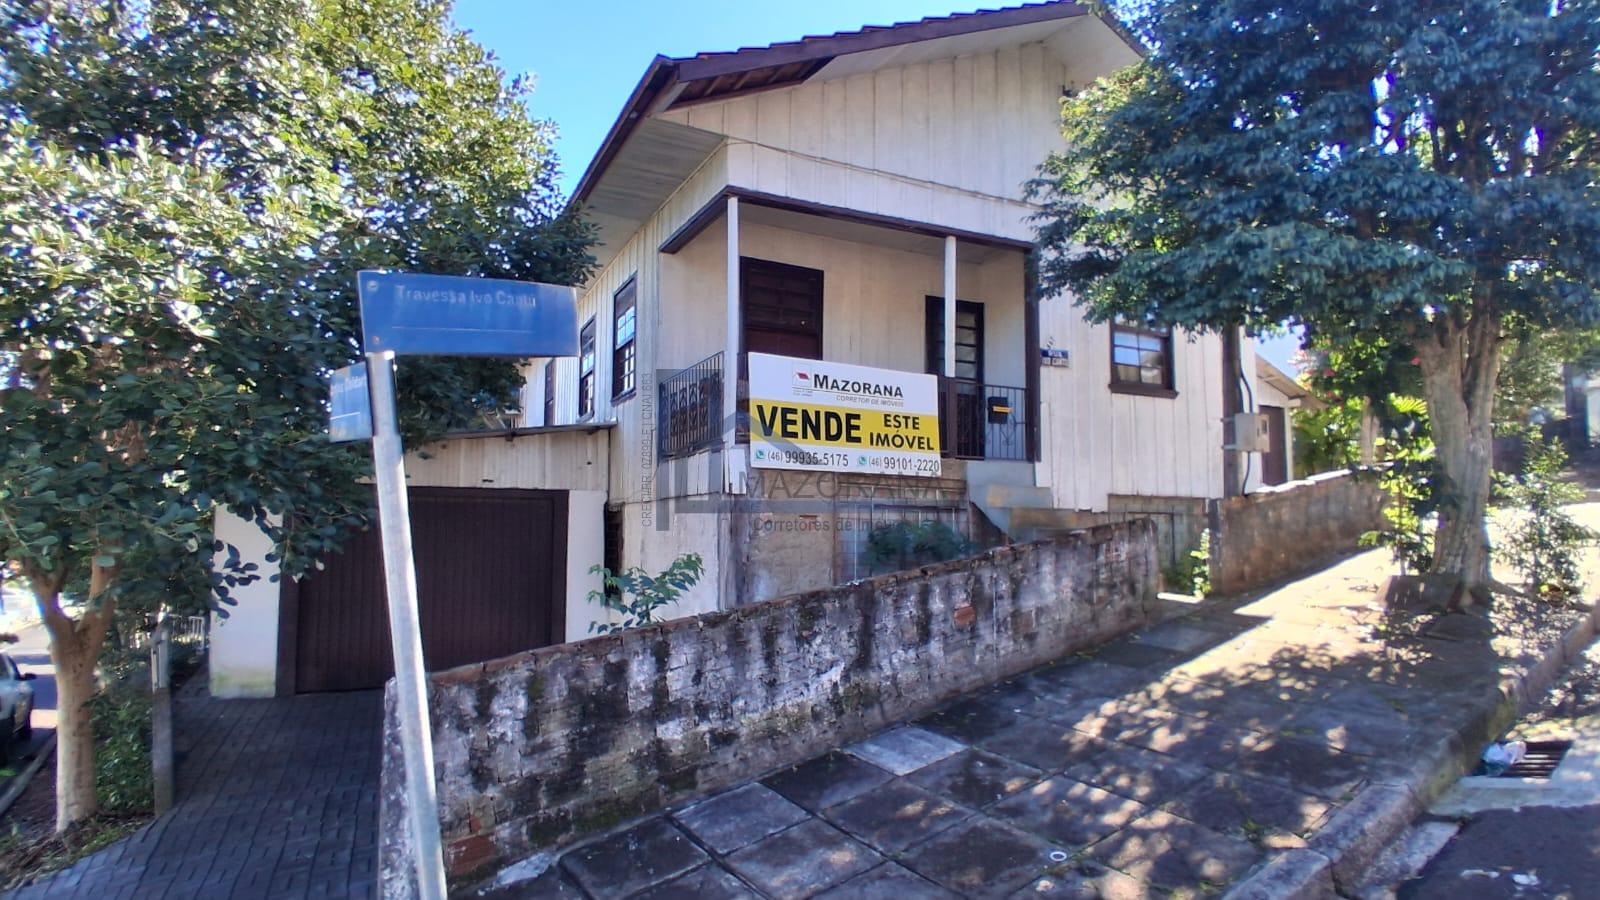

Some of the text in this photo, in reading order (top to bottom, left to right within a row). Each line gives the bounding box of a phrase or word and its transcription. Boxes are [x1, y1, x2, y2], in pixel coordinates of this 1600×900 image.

[395, 284, 466, 303] Travessa
[470, 289, 493, 305] Ivo
[813, 373, 903, 398] MAZORANA
[756, 404, 862, 444] VENDE
[883, 413, 920, 430] ESTE
[869, 429, 935, 451] IMÓVEL
[767, 450, 849, 467] (46) 99935-5175
[868, 456, 940, 472] (46) 99101-2220
